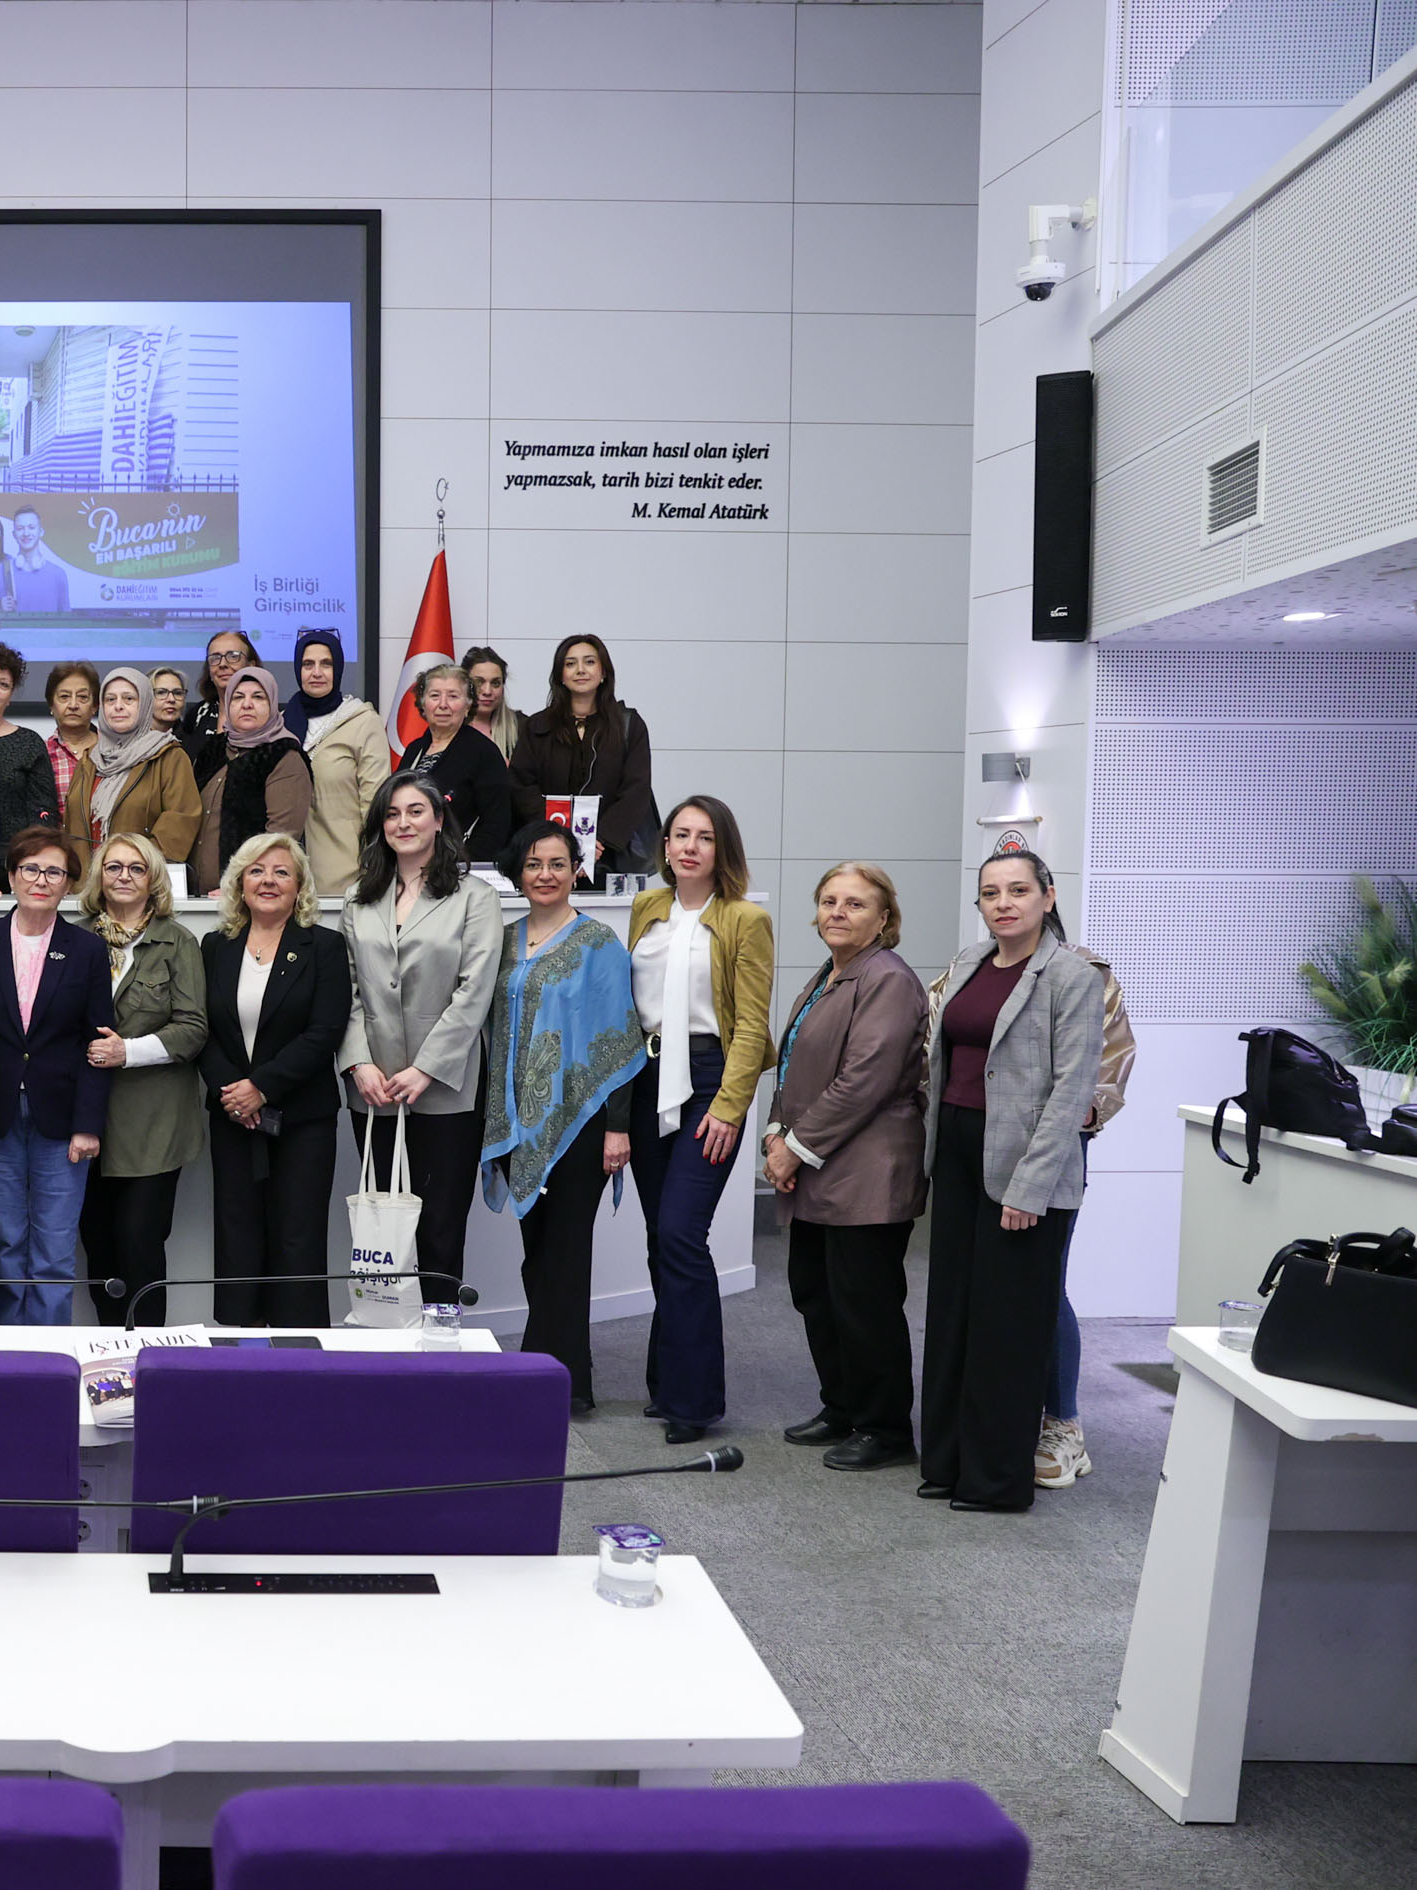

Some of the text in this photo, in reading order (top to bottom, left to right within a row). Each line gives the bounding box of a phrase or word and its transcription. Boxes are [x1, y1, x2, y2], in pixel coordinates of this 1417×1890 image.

[504, 440, 770, 463] Yapmamıza imkan hasıl olan işleri
[504, 471, 763, 490] yapmazsak, tarih bizi tenkit eder.
[631, 502, 769, 520] M. Kemal Atatürk
[95, 539, 177, 566] EN BAŞARILI
[254, 573, 320, 596] İş Birliği
[254, 597, 346, 616] Girişimcilik
[352, 1248, 394, 1265] BUCA
